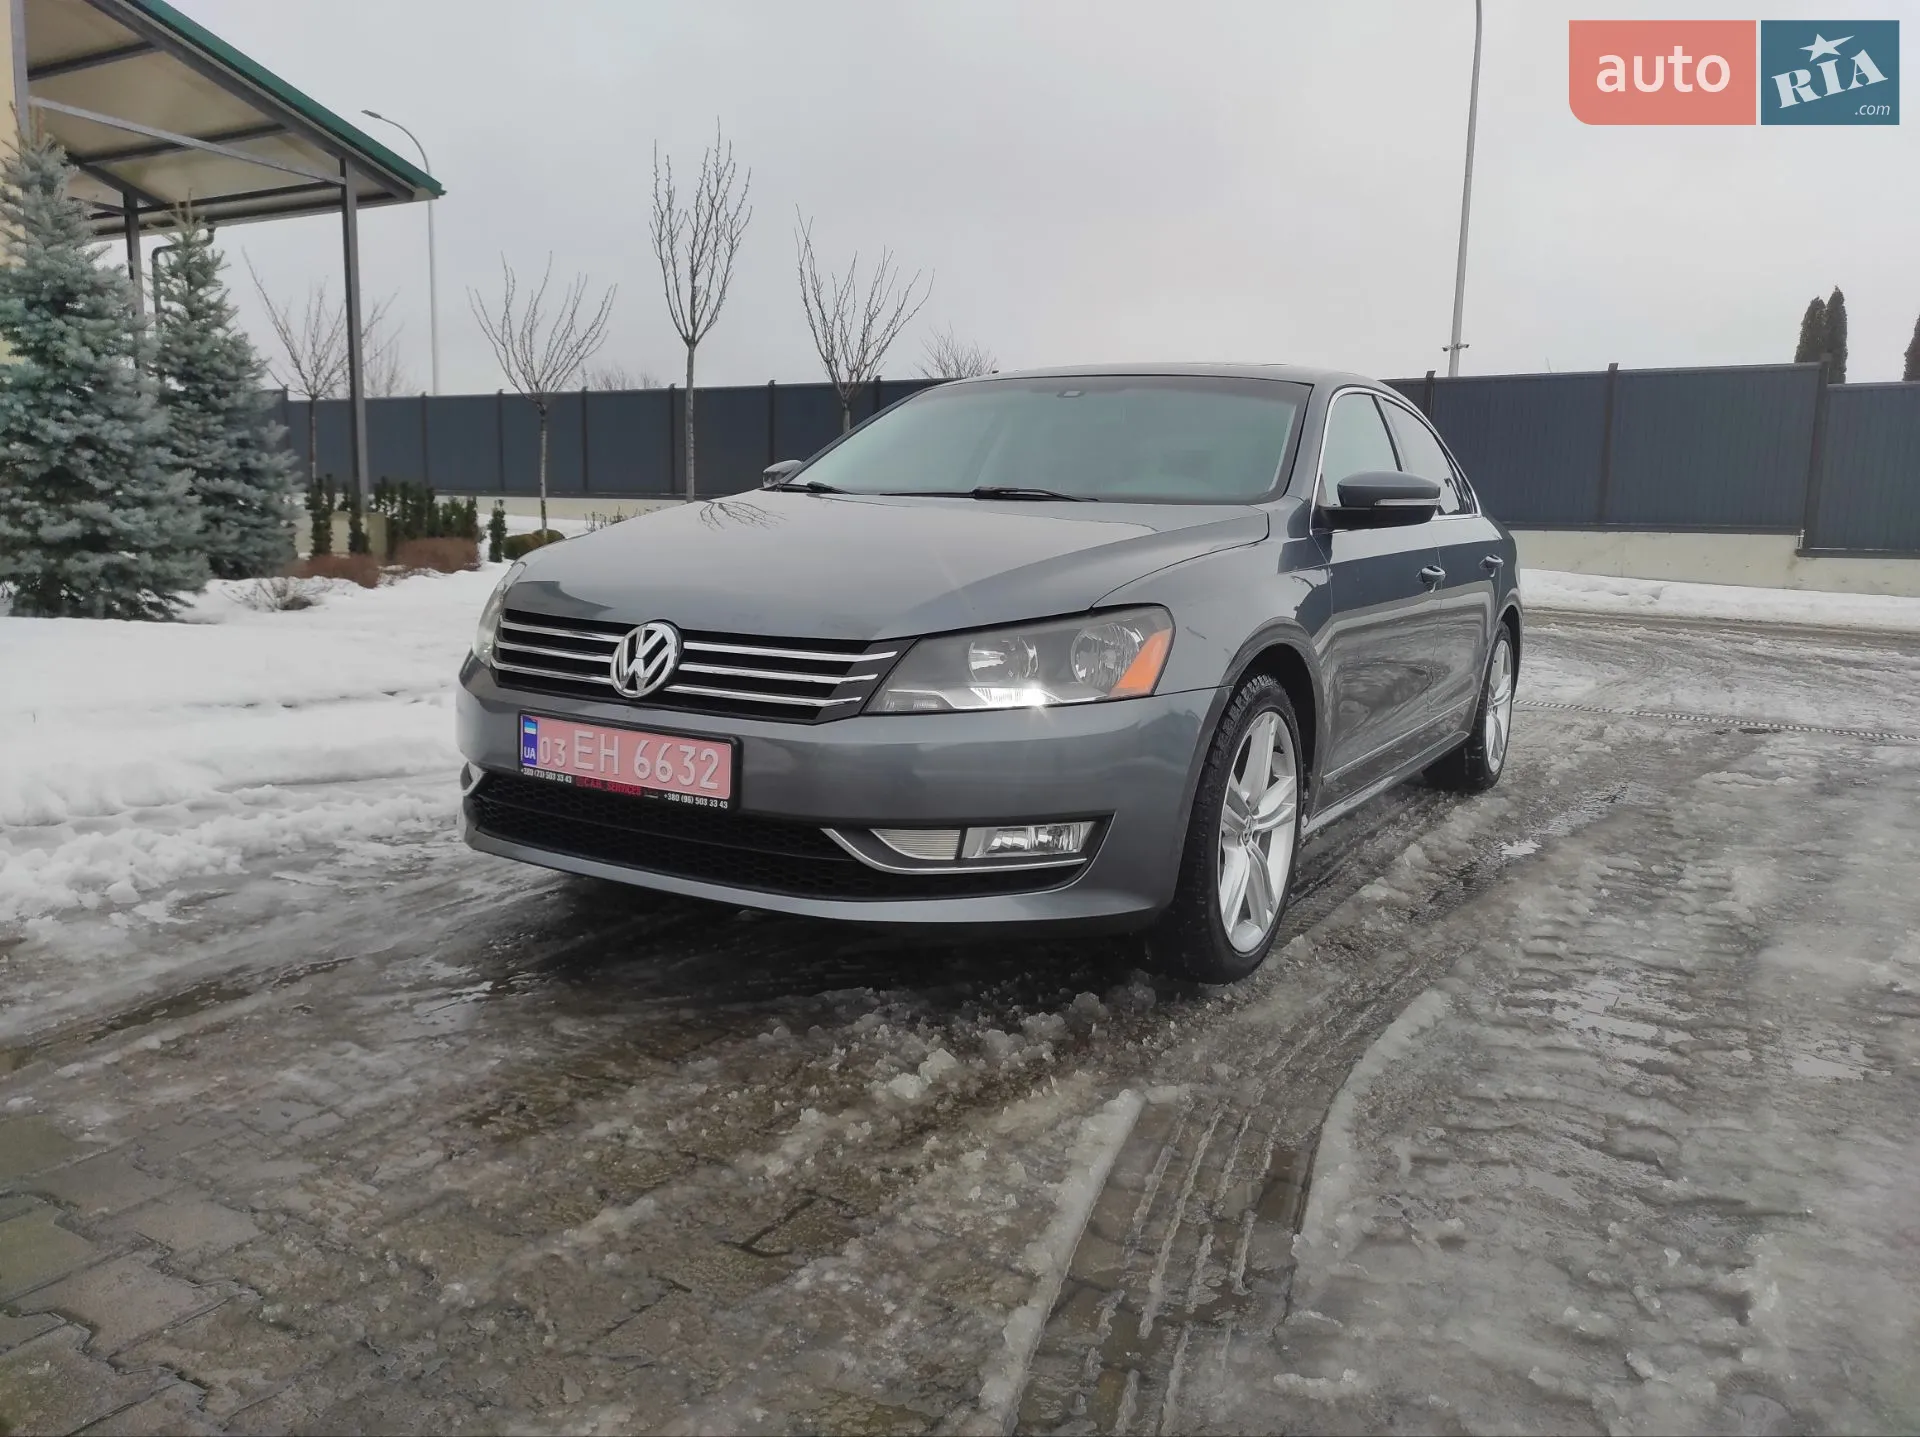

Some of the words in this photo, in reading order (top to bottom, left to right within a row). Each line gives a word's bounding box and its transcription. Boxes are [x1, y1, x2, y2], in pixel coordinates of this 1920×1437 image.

[524, 746, 536, 760] UA
[539, 736, 567, 767] 03
[574, 729, 620, 775] EH
[633, 739, 719, 790] 6632
[664, 792, 680, 802] +380
[695, 796, 708, 806] 503
[709, 799, 718, 808] 33
[719, 800, 728, 809] 43
